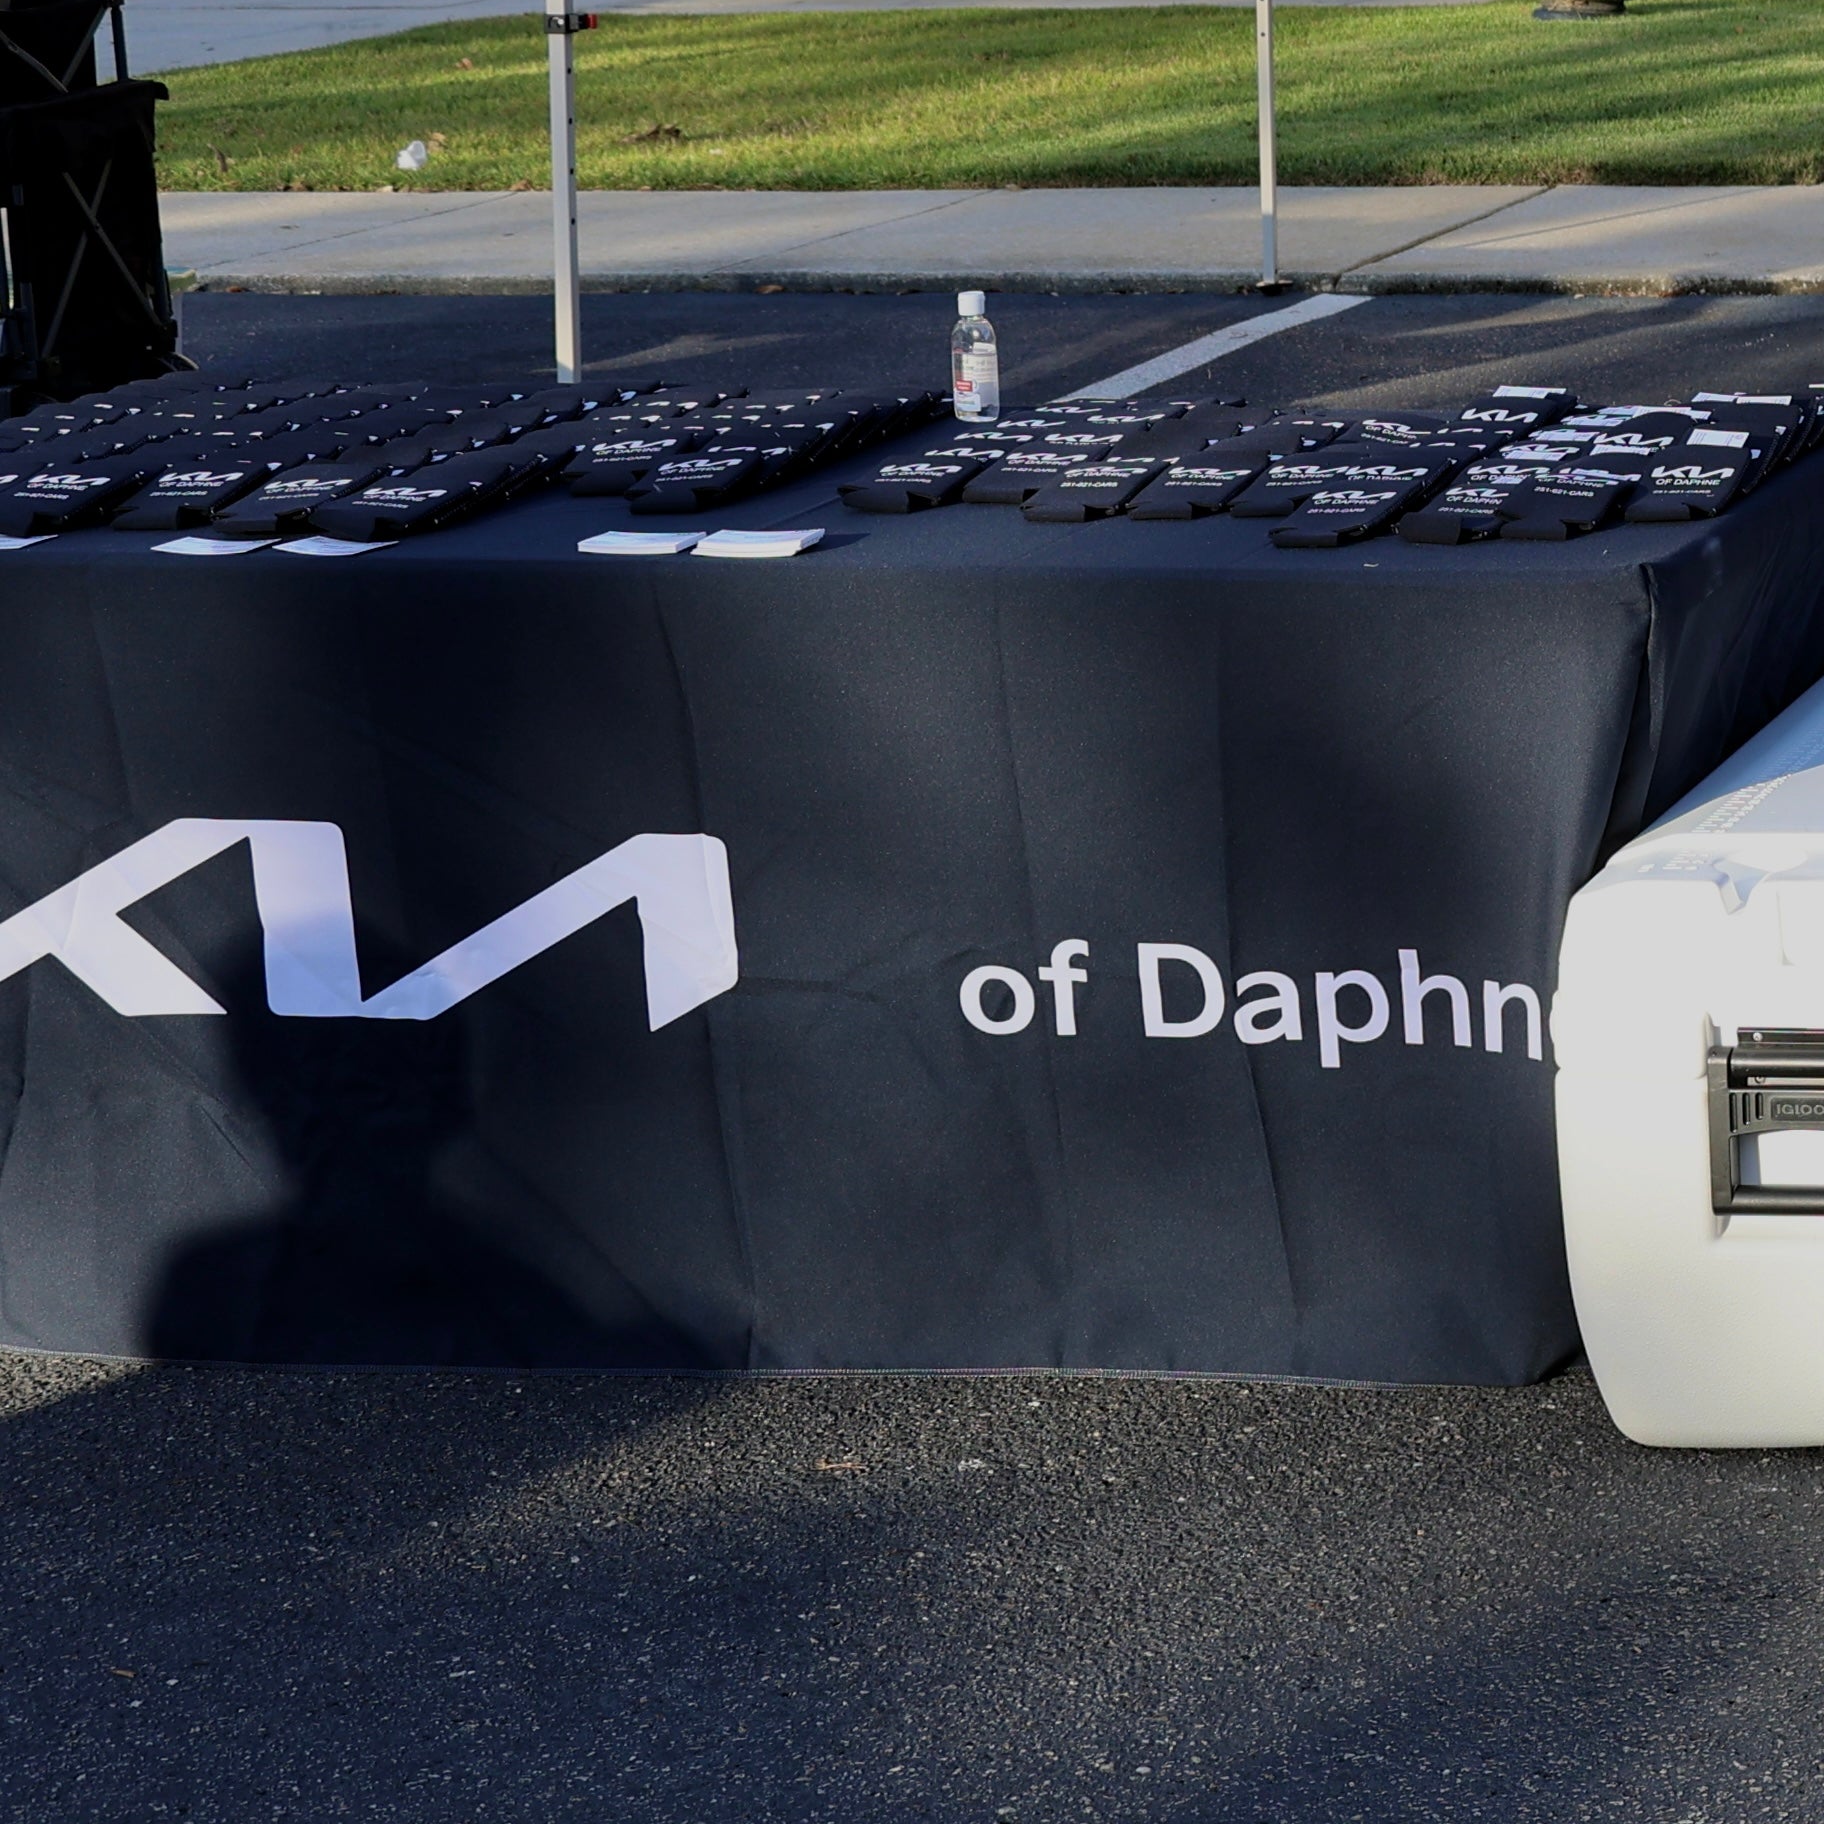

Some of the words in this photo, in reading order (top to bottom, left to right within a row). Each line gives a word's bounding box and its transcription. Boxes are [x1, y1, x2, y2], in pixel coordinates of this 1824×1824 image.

[1461, 408, 1538, 422] KIA
[1593, 432, 1674, 446] KIA
[1346, 465, 1429, 476] KIA
[1651, 465, 1735, 479] KIA
[1312, 490, 1397, 501] KIA
[959, 938, 1089, 1037] of
[1137, 942, 1544, 1069] Daphn
